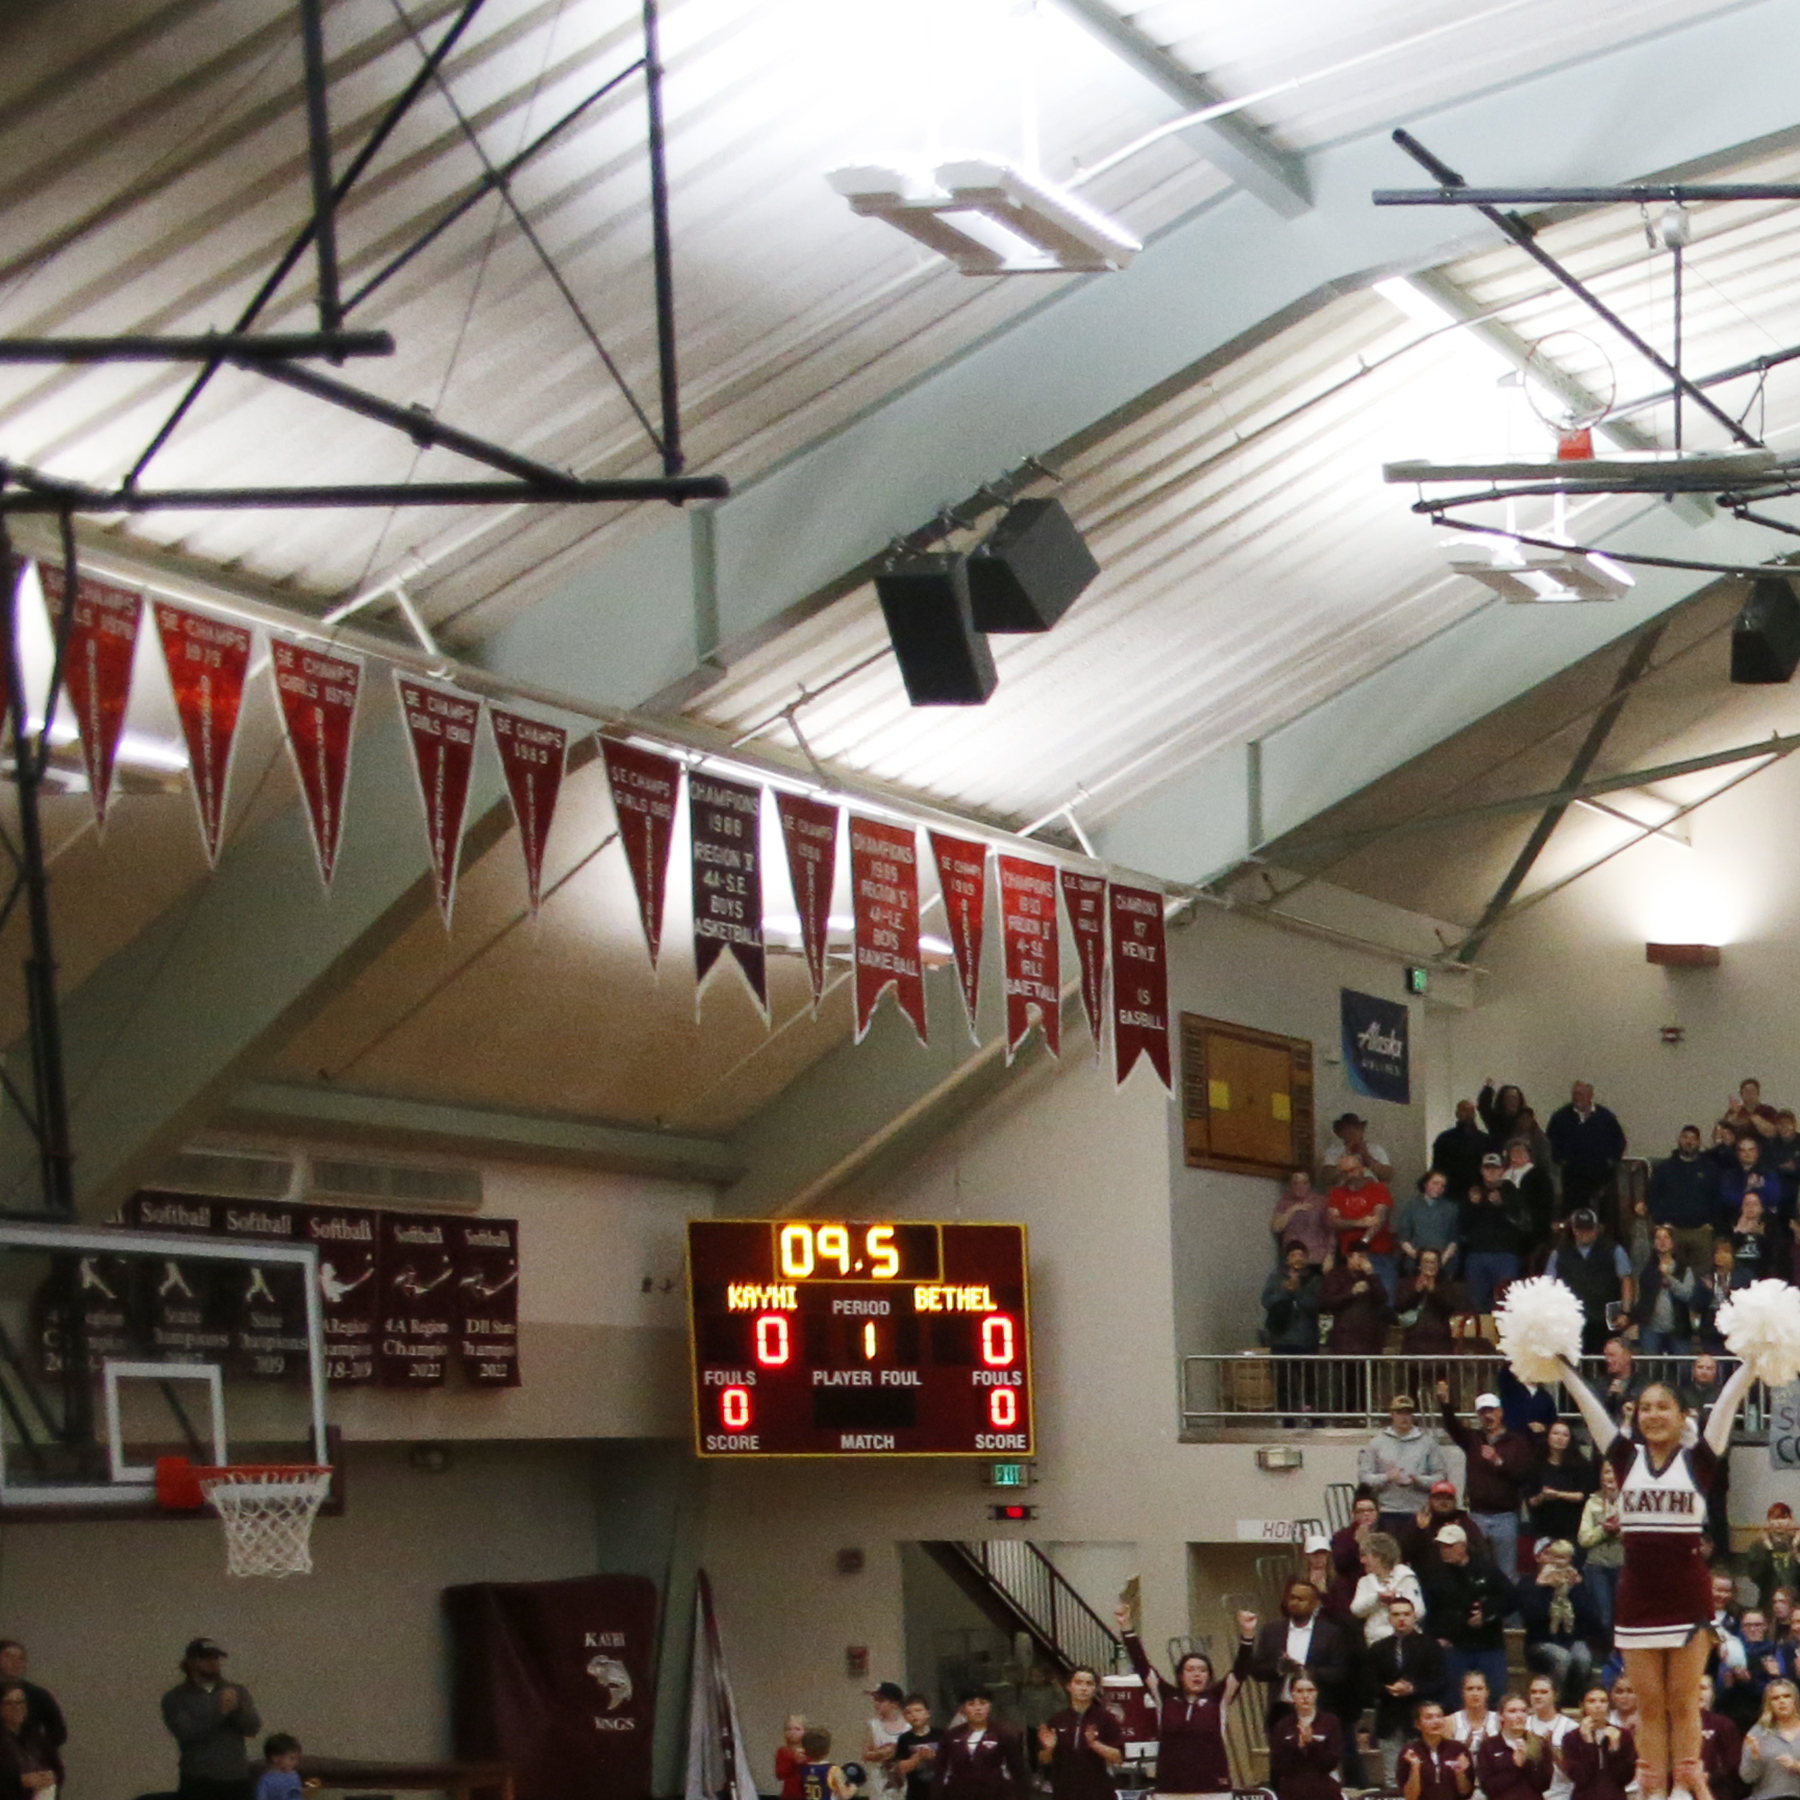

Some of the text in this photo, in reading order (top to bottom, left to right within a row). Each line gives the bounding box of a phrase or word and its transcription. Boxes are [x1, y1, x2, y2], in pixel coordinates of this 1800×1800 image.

[140, 1201, 211, 1228] Softball
[227, 1210, 292, 1235] Softball
[310, 1218, 373, 1241] Softball
[780, 1224, 900, 1279] 09.5
[727, 1283, 798, 1311] KAYHI
[832, 1300, 891, 1316] PERIOD
[914, 1285, 998, 1312] BETHEL
[756, 1315, 790, 1365] 0
[863, 1321, 877, 1360] 1
[981, 1316, 1014, 1366] 0
[704, 1371, 757, 1386] FOULS
[813, 1371, 923, 1386] PLAYER FOUL
[972, 1371, 1022, 1386] FOULS
[722, 1388, 749, 1427] 0
[990, 1388, 1016, 1426] 0
[706, 1435, 760, 1451] SCORE
[841, 1435, 895, 1450] MATCH
[975, 1434, 1026, 1449] SCORE
[1622, 1490, 1695, 1514] KAYHI
